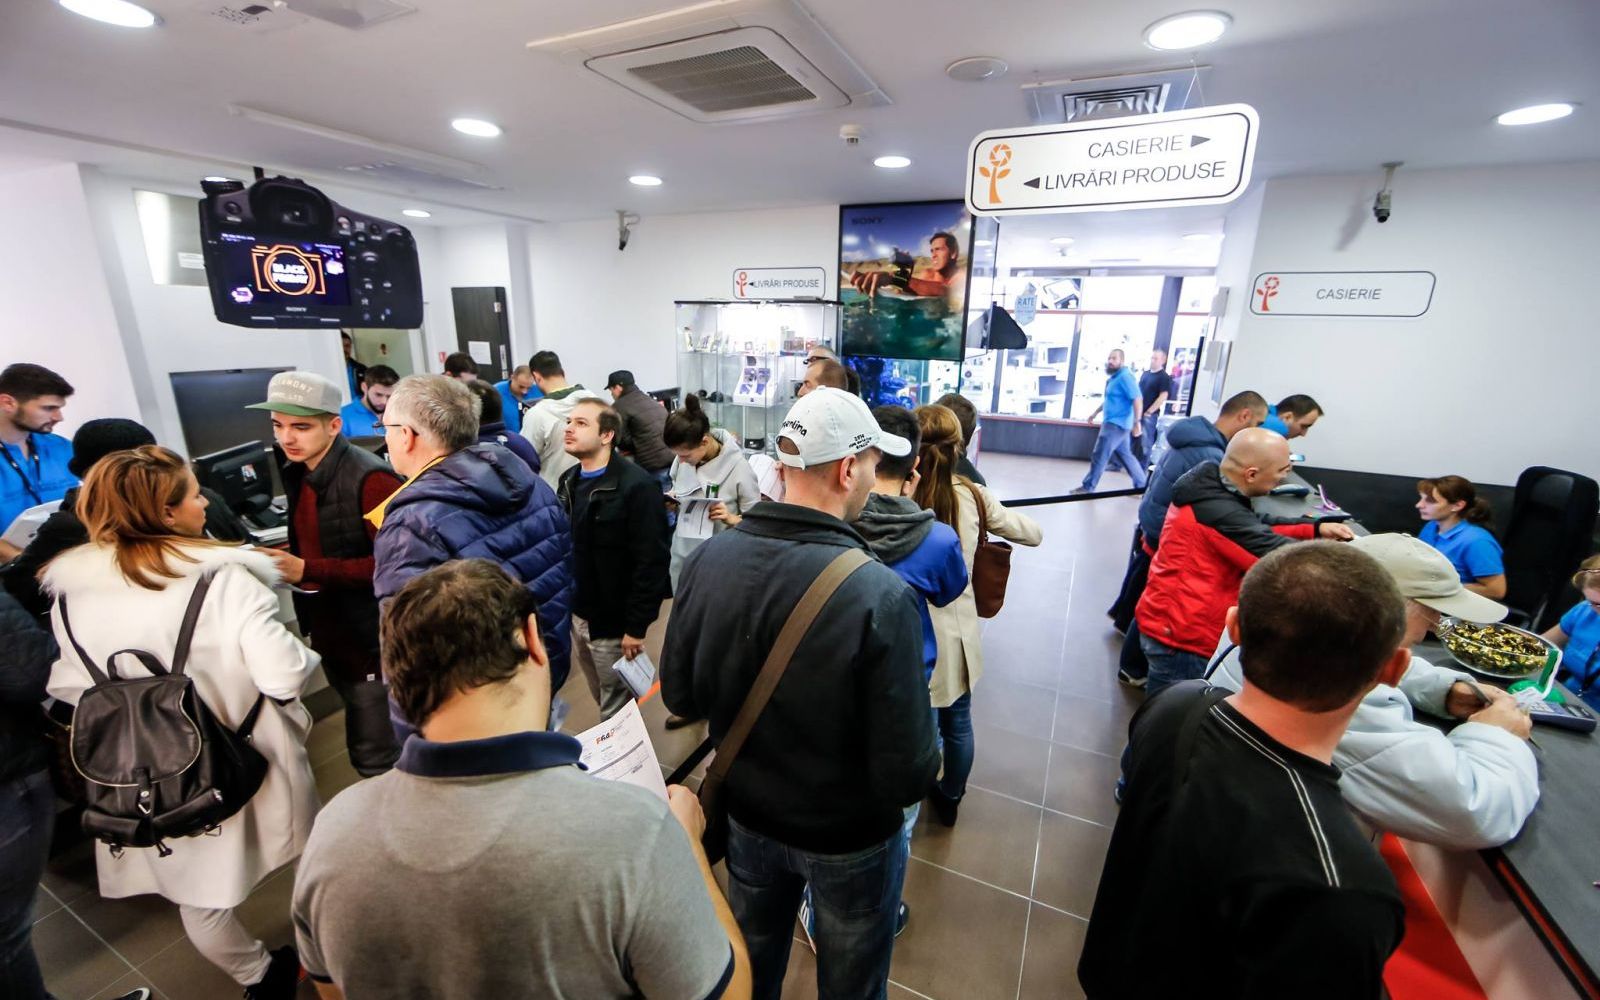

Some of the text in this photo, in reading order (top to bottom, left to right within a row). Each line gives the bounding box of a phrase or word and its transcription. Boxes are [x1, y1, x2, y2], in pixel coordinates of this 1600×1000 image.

[1088, 135, 1184, 159] CASIERIE
[1045, 161, 1227, 190] LIVRĂRI PRODUSE
[782, 279, 819, 288] PRODUSE
[1316, 288, 1382, 300] CASIERIE
